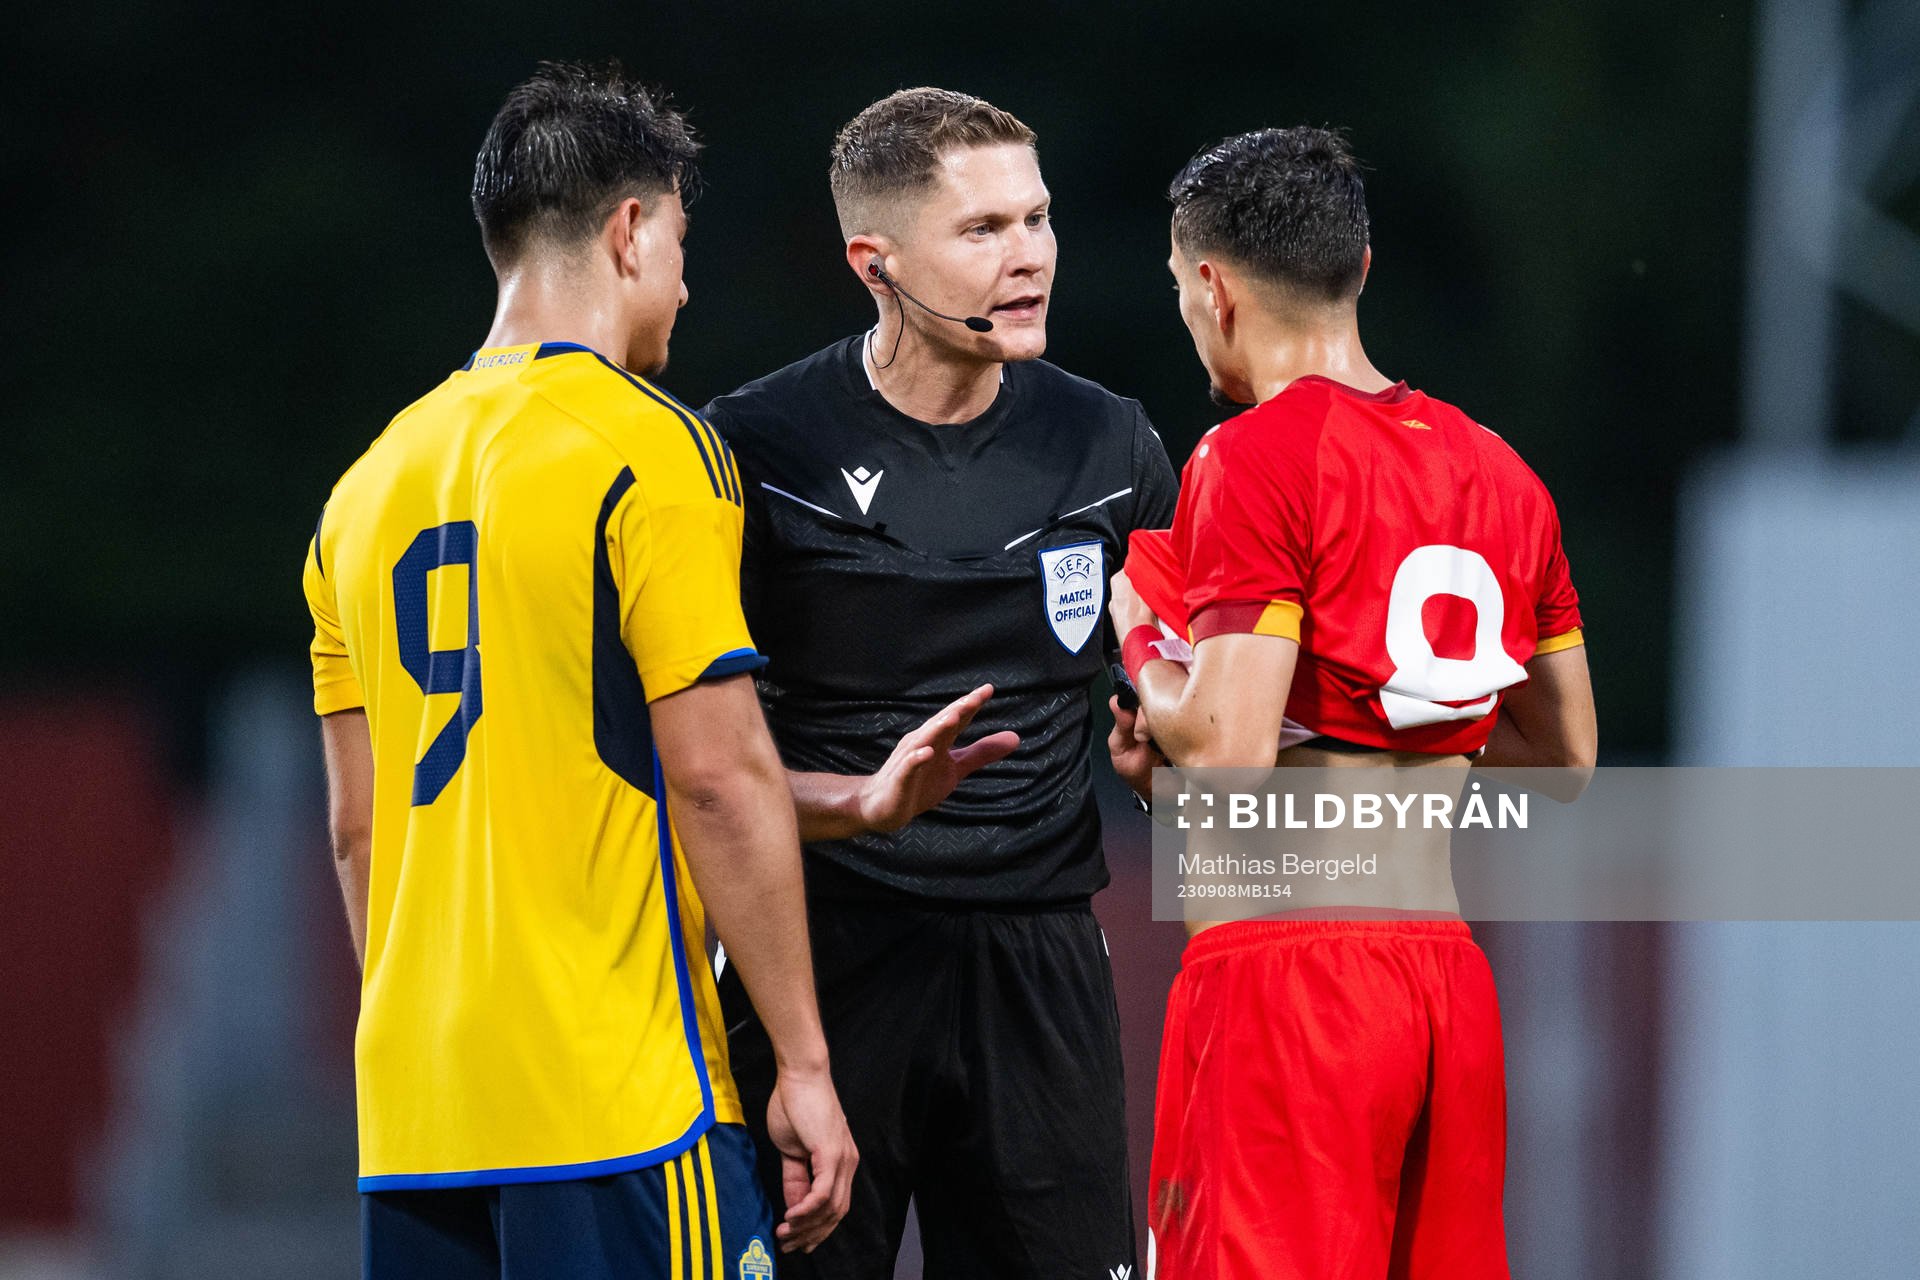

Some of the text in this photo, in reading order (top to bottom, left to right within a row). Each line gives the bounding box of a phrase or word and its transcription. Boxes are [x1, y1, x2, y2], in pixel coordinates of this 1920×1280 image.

[474, 351, 529, 371] SVERIGE
[1056, 558, 1090, 579] UEFA
[1059, 588, 1093, 605] MATCH
[1055, 604, 1096, 622] OFFICIAL
[392, 520, 483, 807] 9
